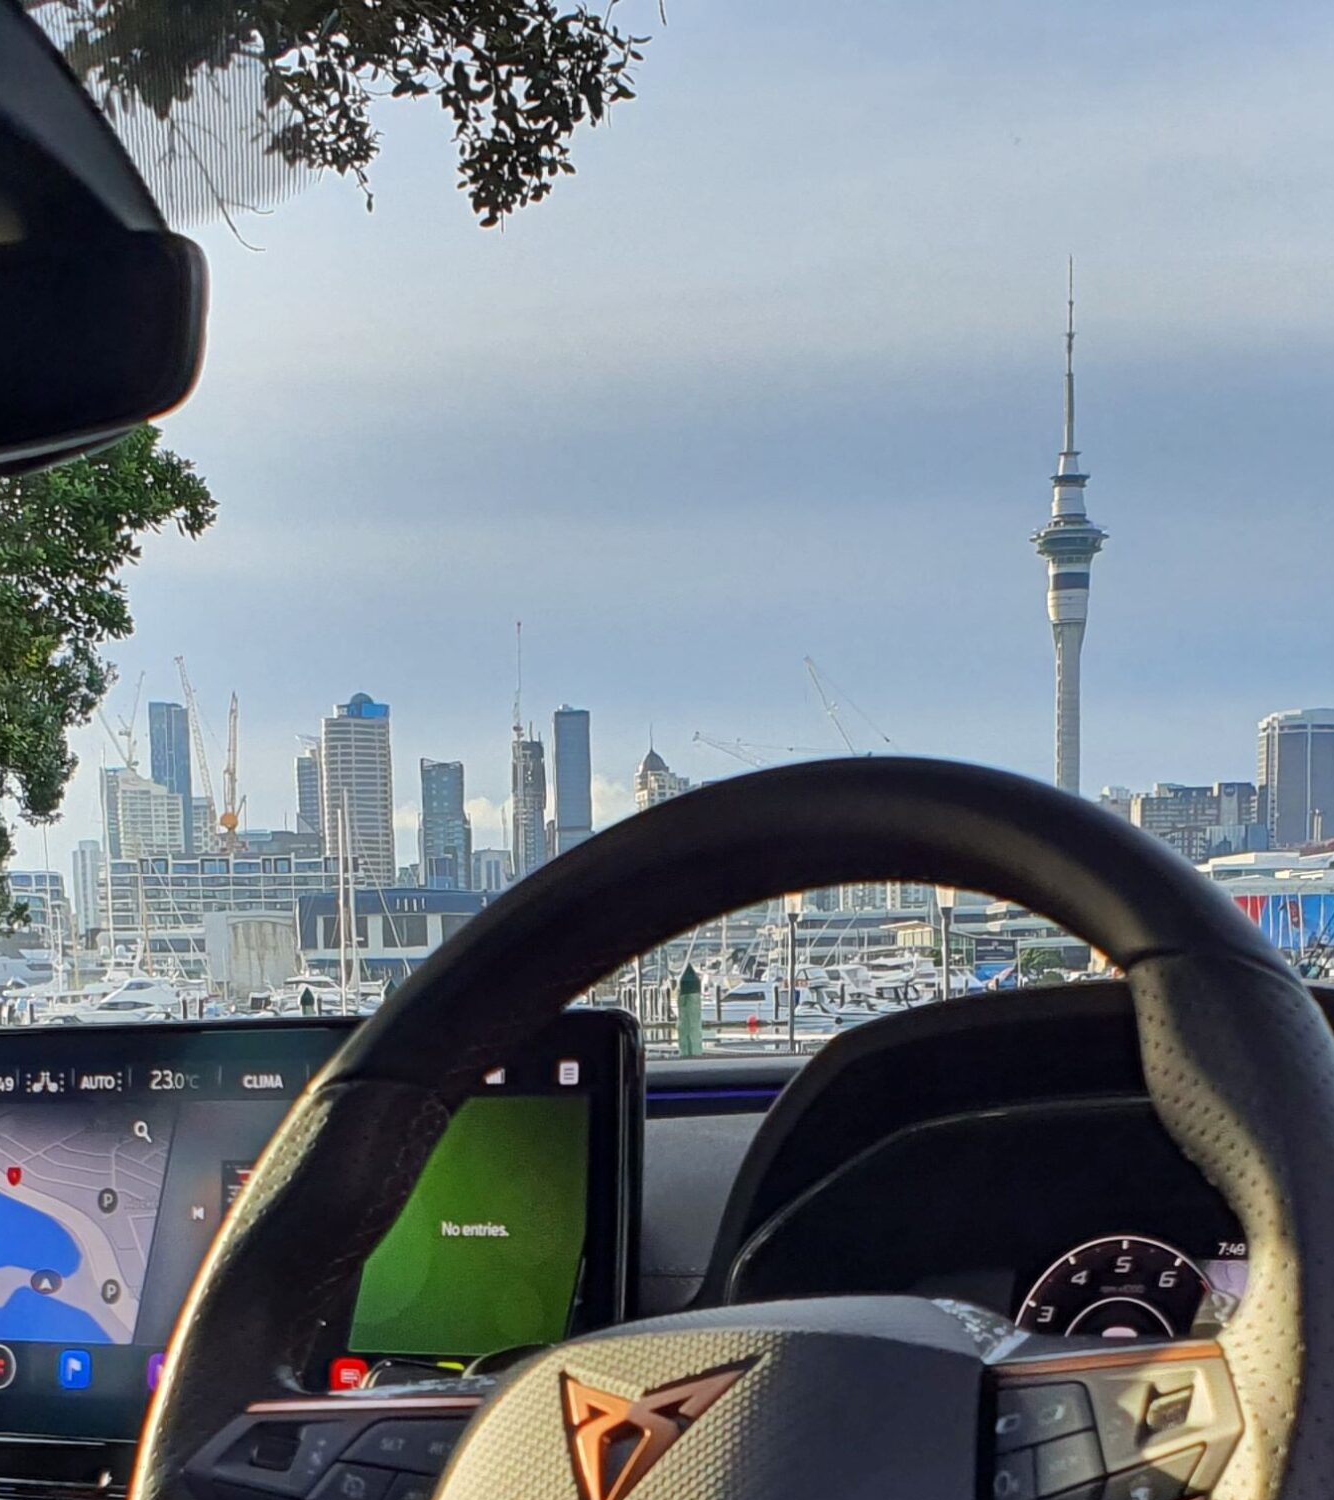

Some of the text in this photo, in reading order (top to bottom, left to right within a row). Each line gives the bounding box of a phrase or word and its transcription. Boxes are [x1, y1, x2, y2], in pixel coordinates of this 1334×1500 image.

[80, 1075, 115, 1090] AUTO
[242, 1074, 284, 1089] CLIMA
[441, 1220, 510, 1237] No entries.
[1218, 1242, 1246, 1256] 7:49
[1113, 1256, 1132, 1274] 5
[1070, 1270, 1089, 1286] 4
[1158, 1271, 1177, 1288] 6
[1036, 1305, 1055, 1322] 3
